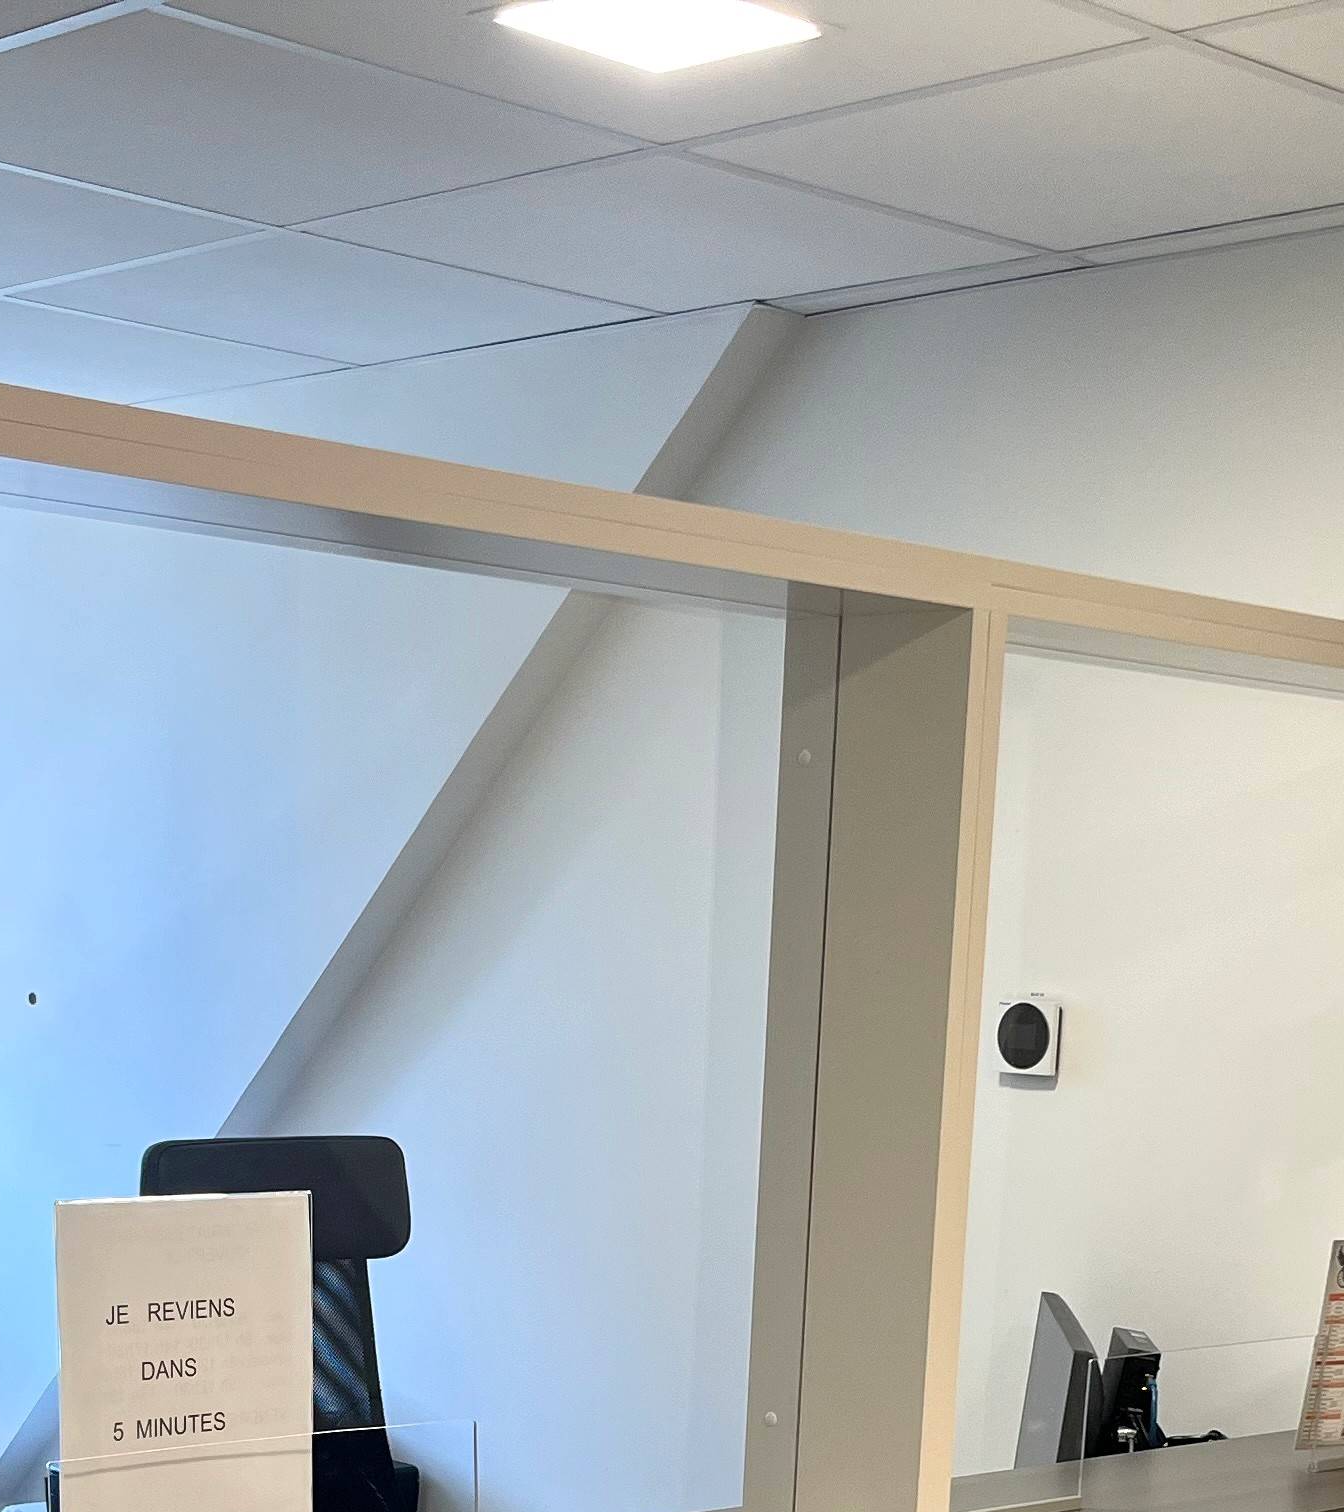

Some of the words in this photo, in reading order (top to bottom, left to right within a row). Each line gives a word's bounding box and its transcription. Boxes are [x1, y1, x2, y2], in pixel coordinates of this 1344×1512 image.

[106, 1305, 129, 1325] JE
[148, 1298, 234, 1322] REVIENS
[142, 1358, 196, 1380] DANS
[114, 1422, 123, 1441] 5
[137, 1412, 225, 1439] MINUTES
